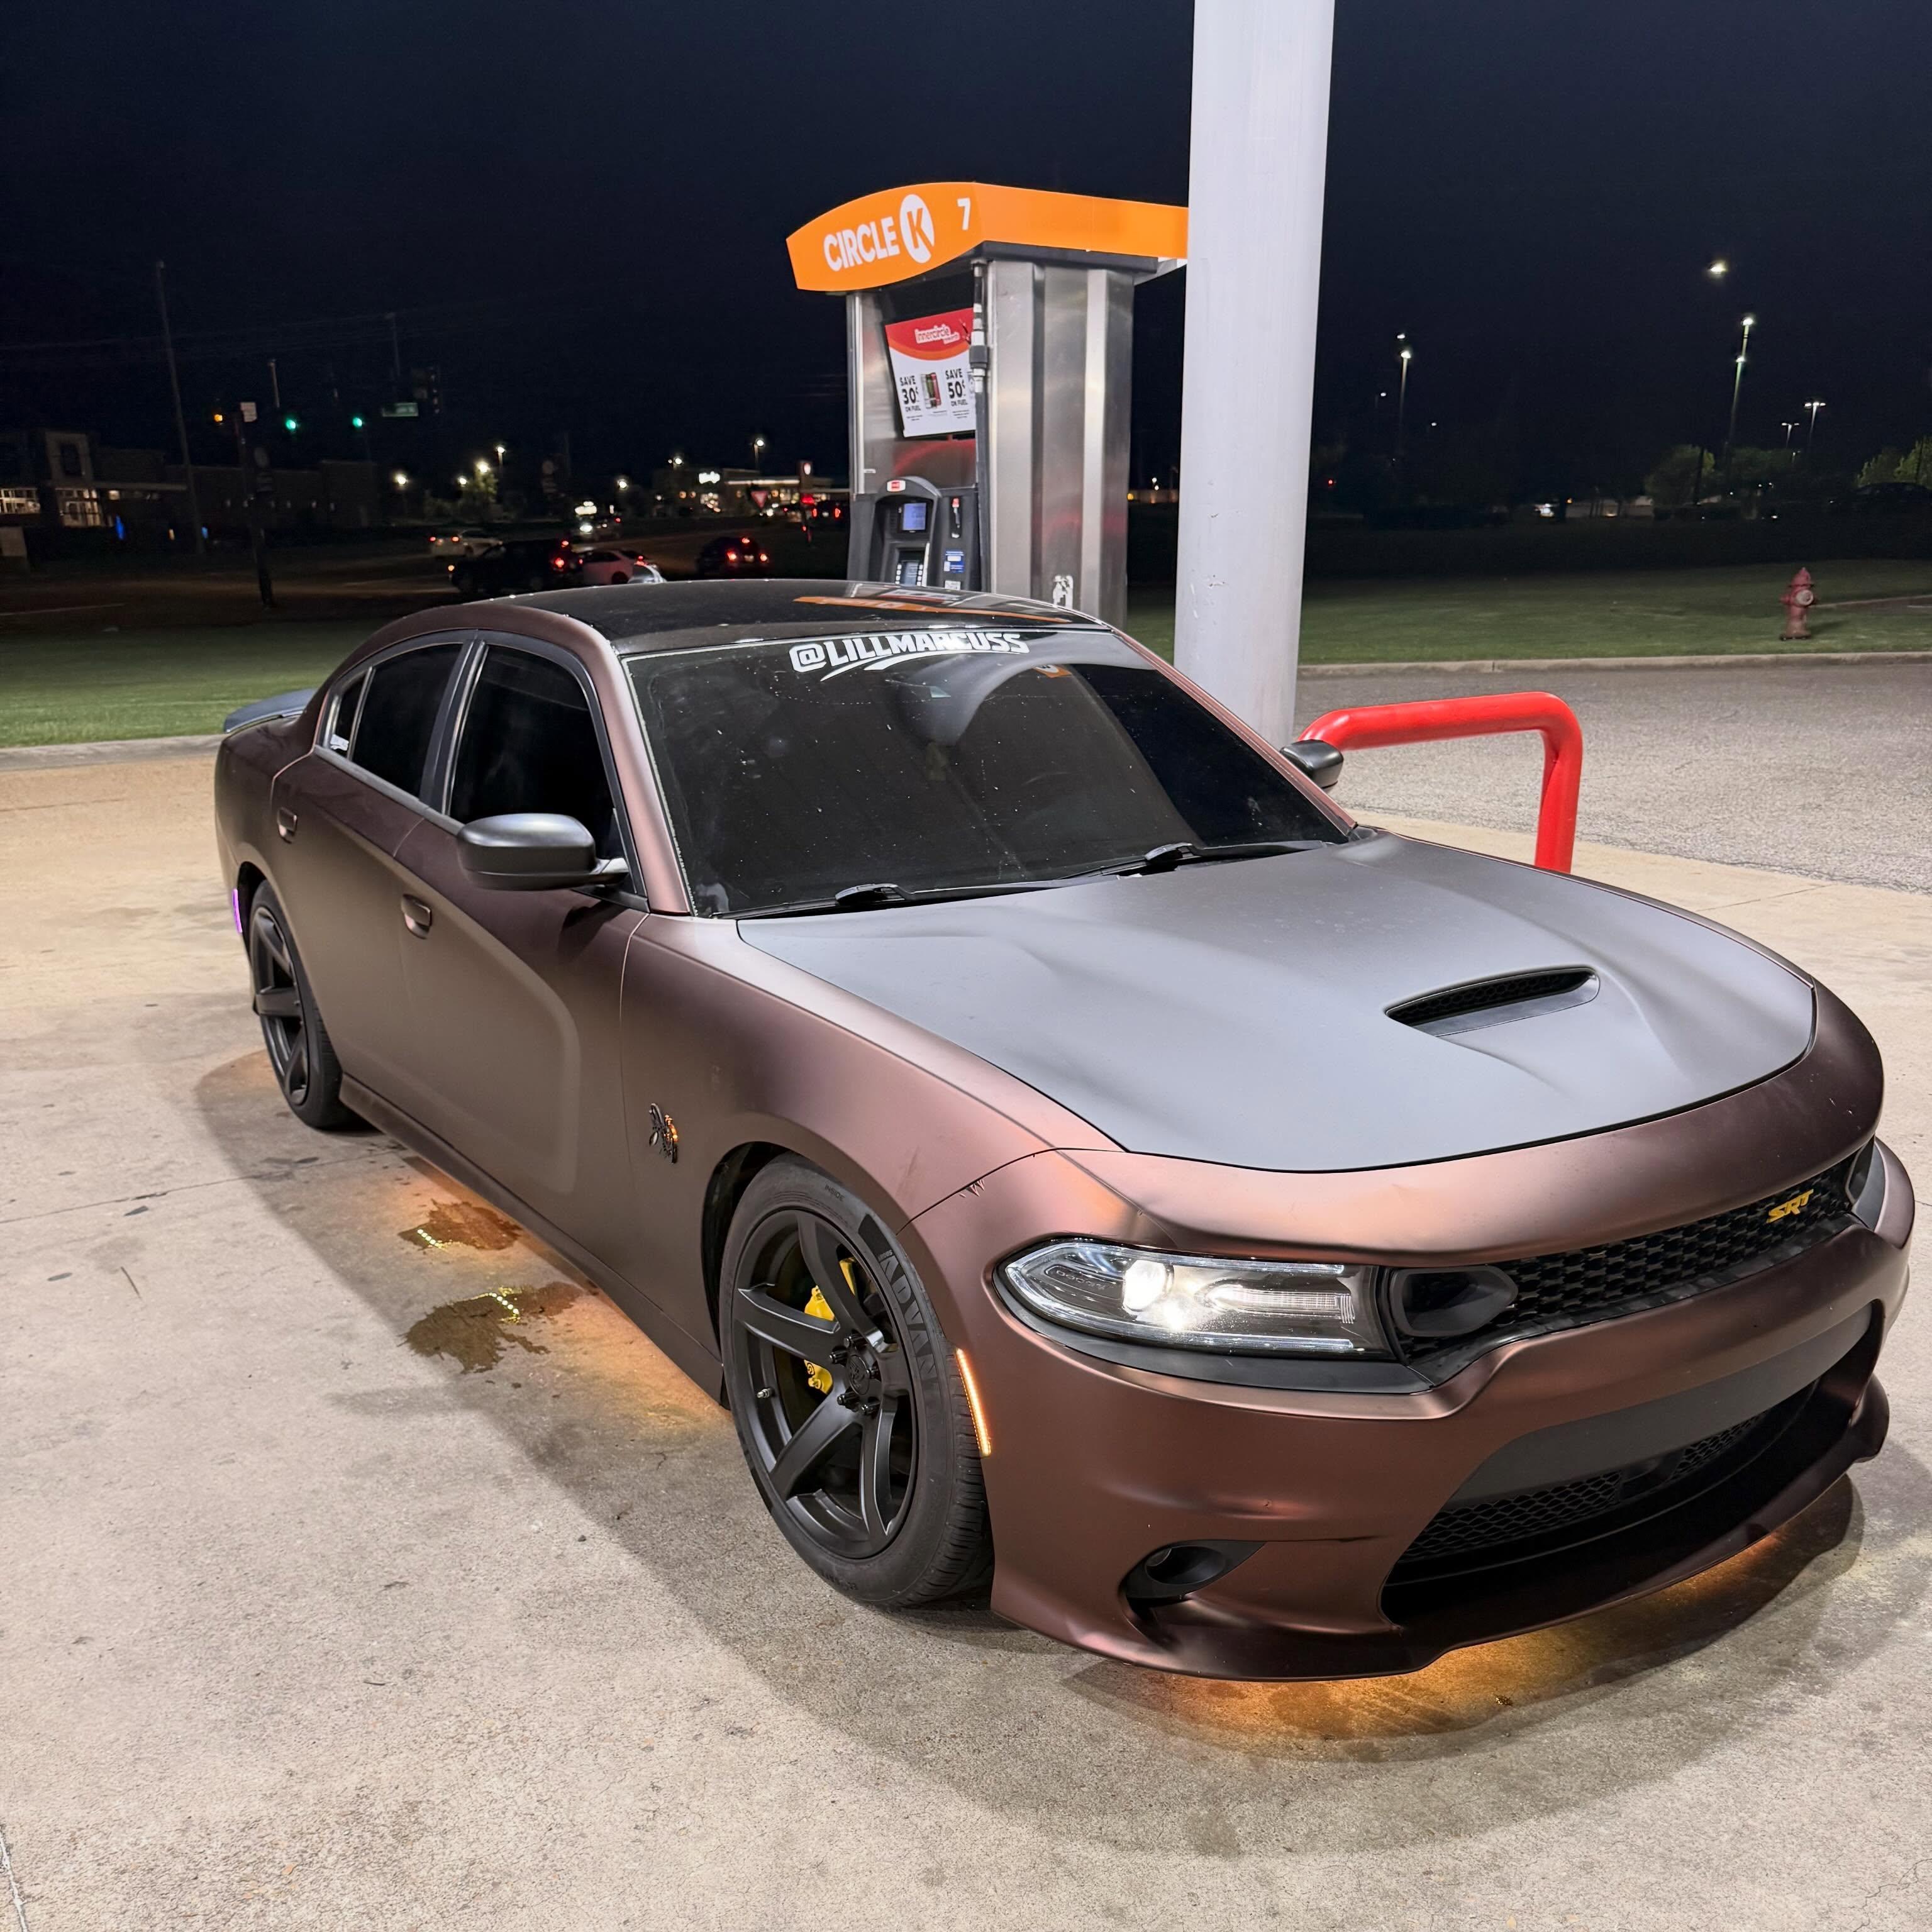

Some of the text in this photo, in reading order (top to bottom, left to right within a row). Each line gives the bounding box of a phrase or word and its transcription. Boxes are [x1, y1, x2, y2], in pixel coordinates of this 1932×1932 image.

[957, 197, 971, 231] 7
[823, 216, 901, 272] CIRCLE
[900, 375, 916, 386] SAVE
[945, 369, 963, 380] SAVE
[1766, 1189, 1814, 1223] SRT
[880, 1255, 938, 1380] ADVAN
